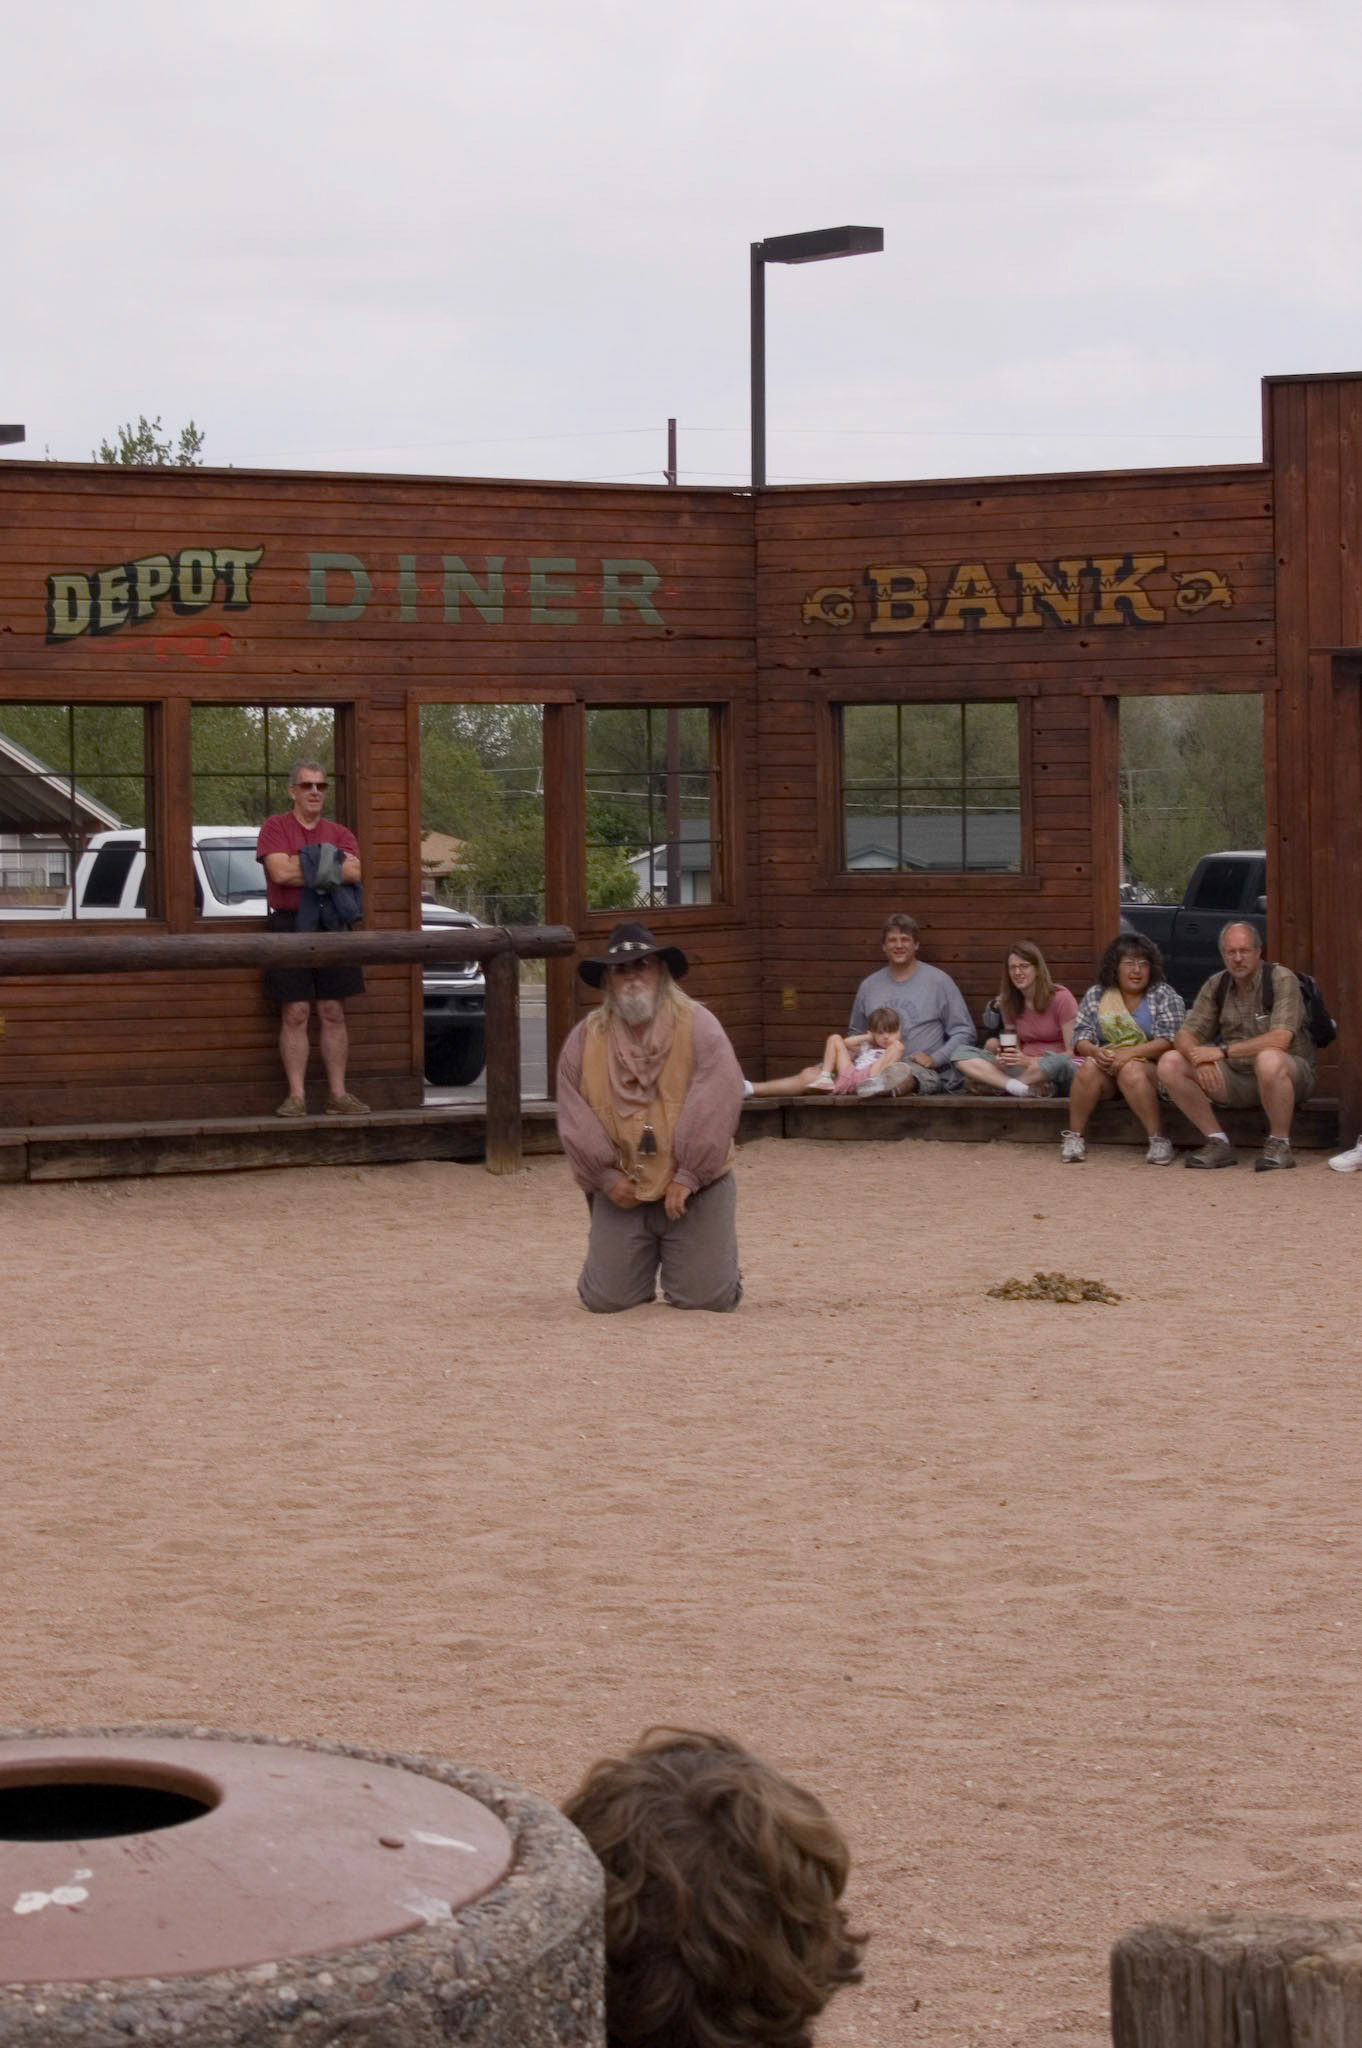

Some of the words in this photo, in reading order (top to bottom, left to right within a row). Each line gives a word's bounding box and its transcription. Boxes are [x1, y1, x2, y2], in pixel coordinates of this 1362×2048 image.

[46, 545, 266, 643] DEPOT
[307, 551, 666, 626] DINER
[865, 551, 1167, 637] BANK
